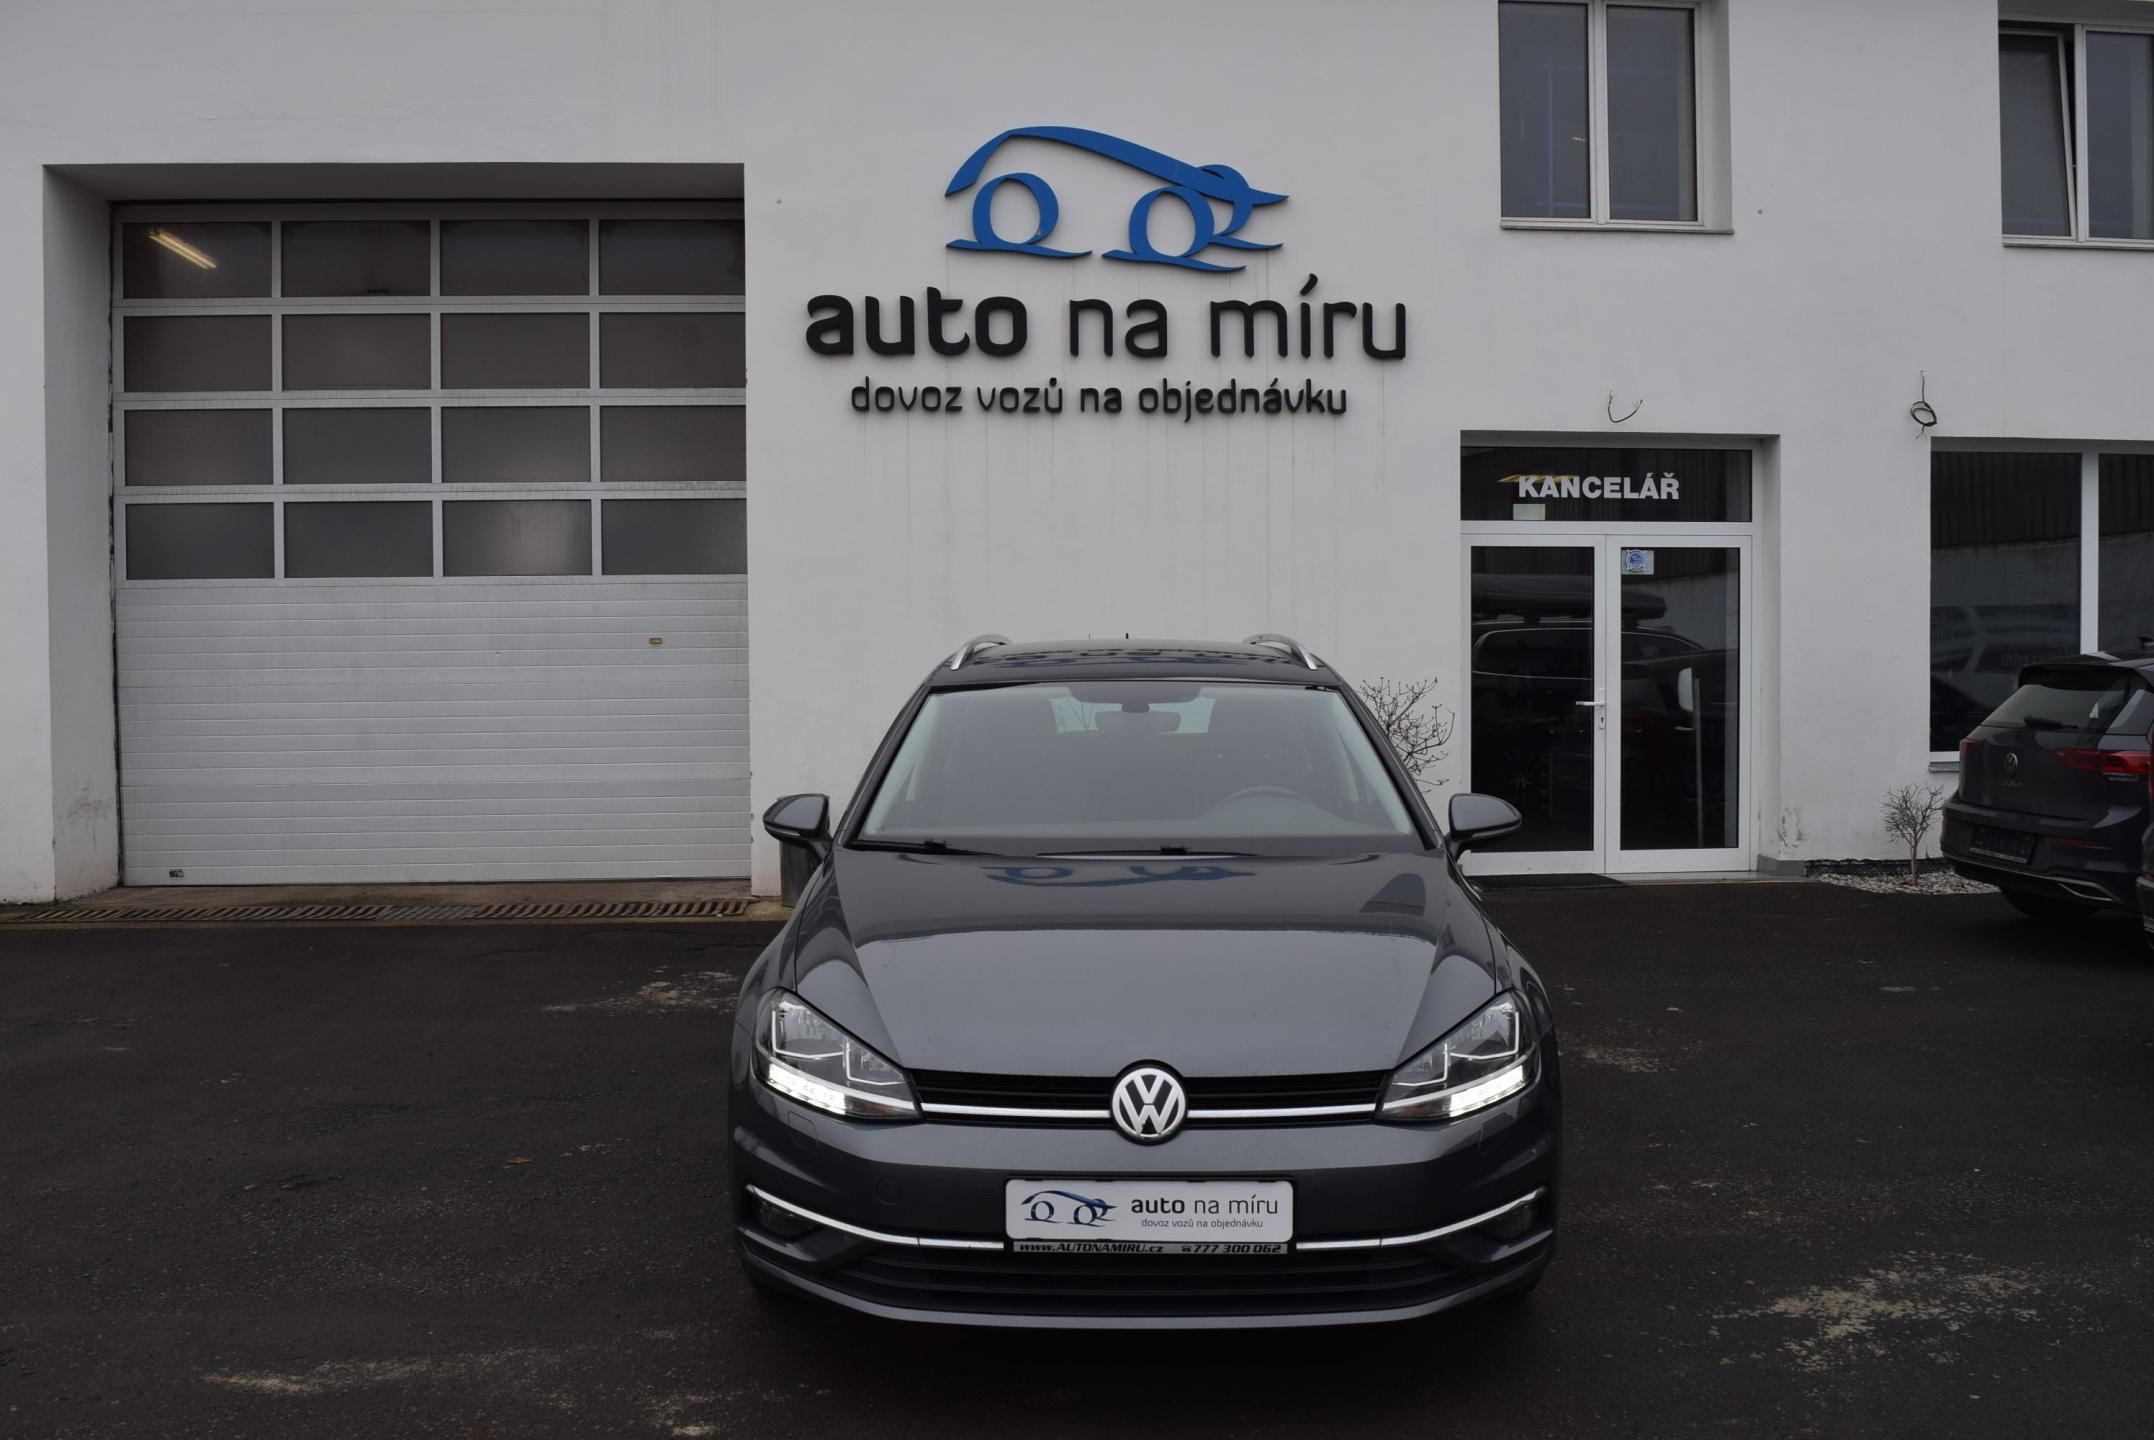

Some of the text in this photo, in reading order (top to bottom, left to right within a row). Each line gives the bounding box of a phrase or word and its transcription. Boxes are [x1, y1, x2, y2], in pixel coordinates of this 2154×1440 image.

[806, 273, 1406, 360] auto na míru
[852, 376, 1346, 423] dovoz vozů na objednávku
[1518, 472, 1679, 500] KANCELÁŘ
[1132, 1195, 1277, 1214] auto na míru
[1142, 1218, 1169, 1227] dovoz
[1172, 1219, 1193, 1227] vozů
[1211, 1219, 1262, 1229] objednávku
[1193, 1244, 1219, 1253] 777
[1222, 1244, 1250, 1253] 300
